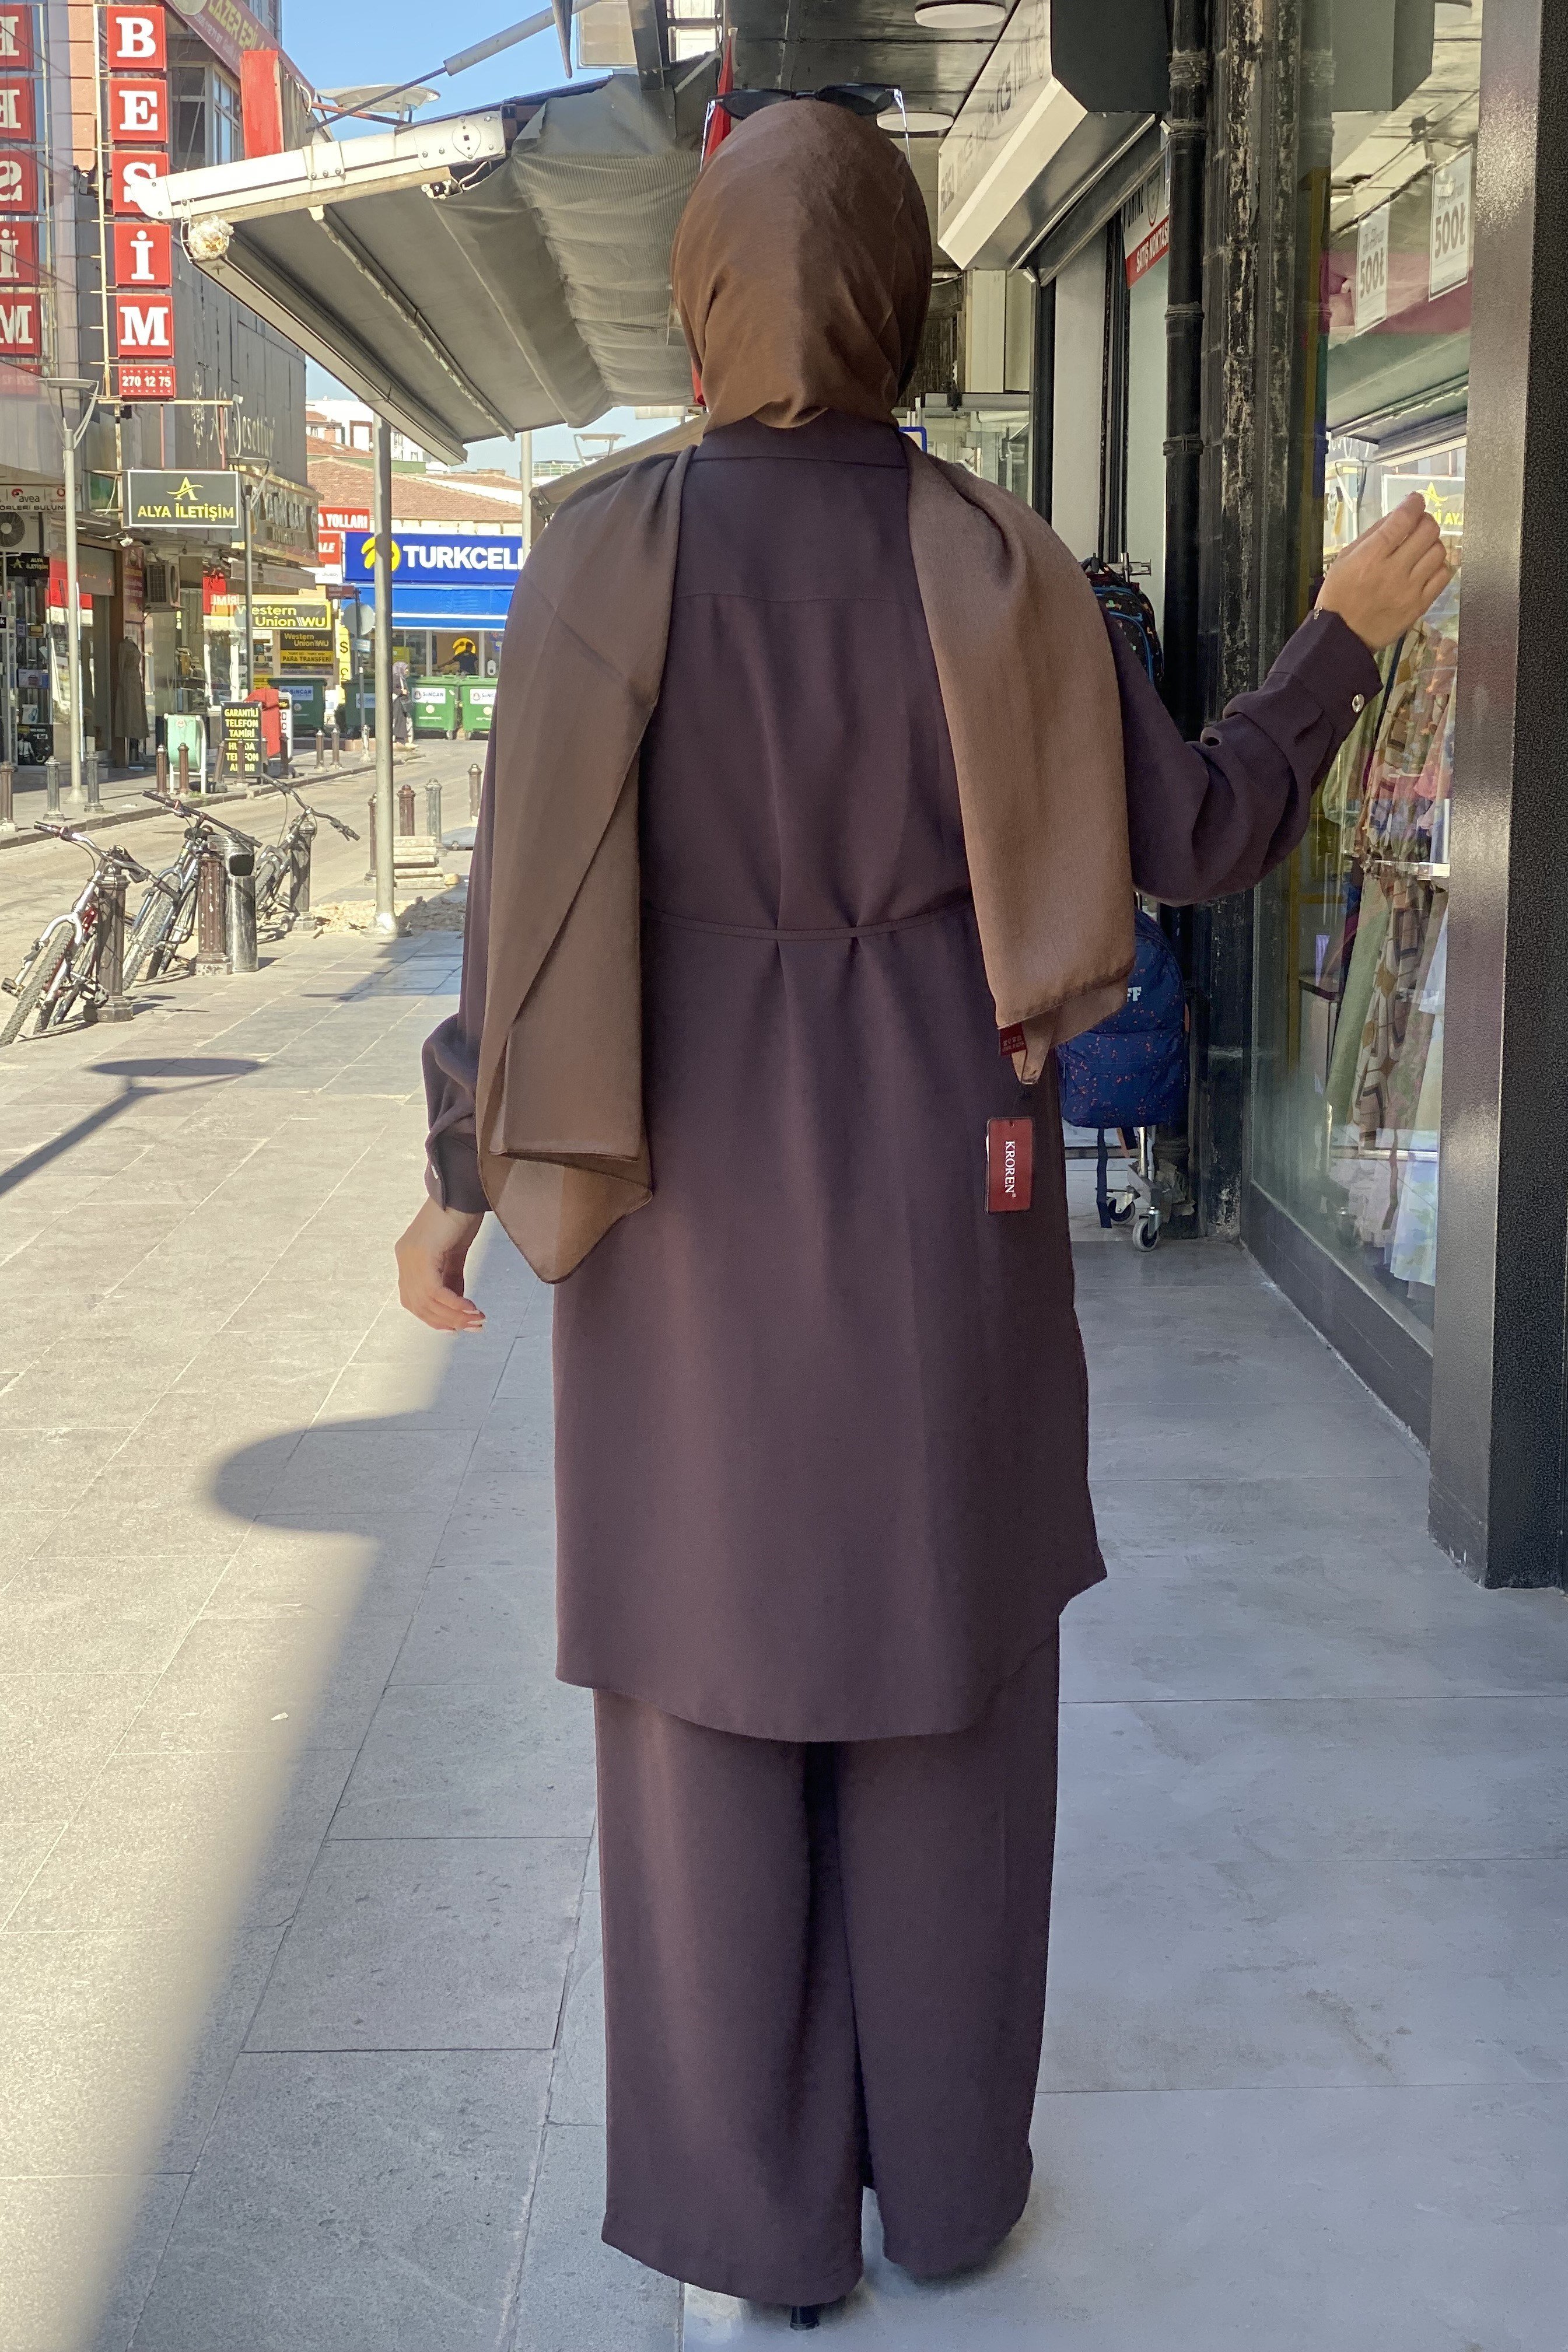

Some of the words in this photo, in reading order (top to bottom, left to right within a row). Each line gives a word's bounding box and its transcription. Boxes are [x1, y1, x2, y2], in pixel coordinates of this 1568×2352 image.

[122, 376, 141, 387] 270
[144, 376, 156, 387] 12
[158, 376, 172, 387] 75
[138, 505, 172, 517] ALYA
[175, 502, 234, 522] İLETİŞİM
[326, 514, 368, 528] YOLLARI
[255, 617, 296, 627] Union
[302, 617, 326, 627] WU
[224, 707, 258, 717] GARANTİLİ
[225, 719, 258, 727] TELEFON
[229, 729, 254, 738] TAMİRİ
[225, 753, 258, 761] TEON
[1005, 1140, 1016, 1194] KROREN
